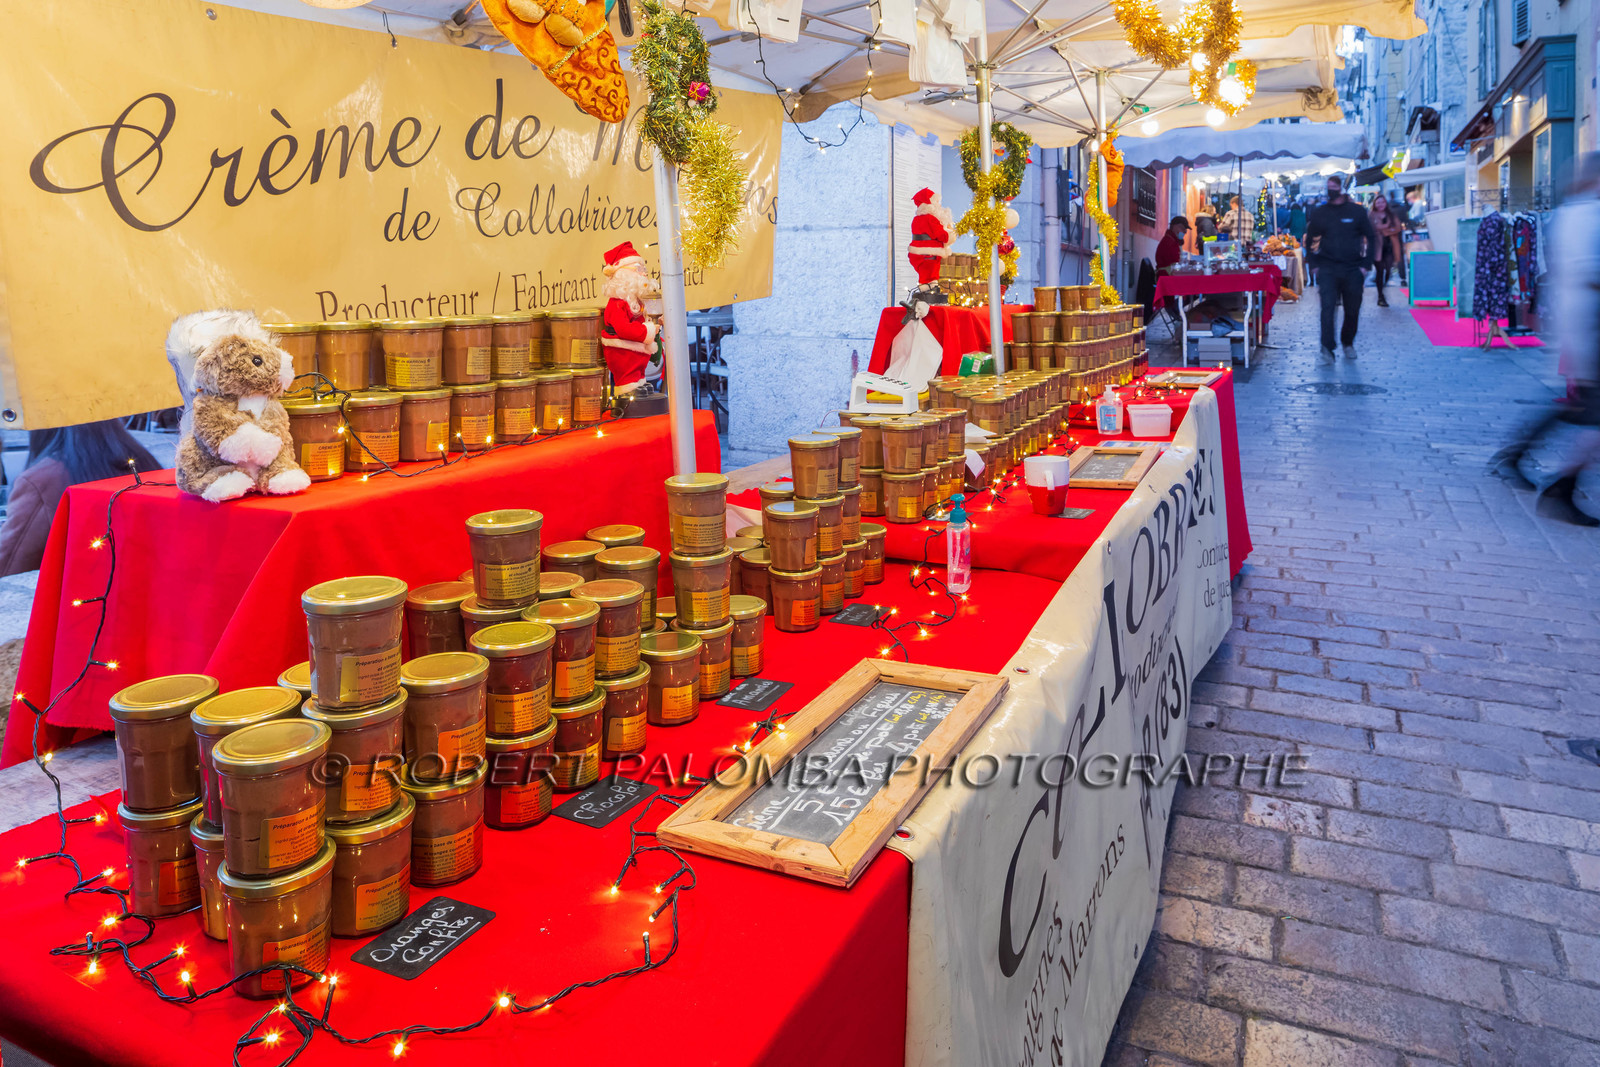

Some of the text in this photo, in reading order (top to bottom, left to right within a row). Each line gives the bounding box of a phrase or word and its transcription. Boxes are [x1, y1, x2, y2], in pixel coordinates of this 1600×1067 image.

[30, 91, 440, 232] Crème
[464, 77, 556, 161] de
[384, 188, 441, 244] de
[512, 268, 597, 311] Fabricant
[1155, 634, 1188, 768] (83)
[1058, 823, 1125, 1011] Marrons
